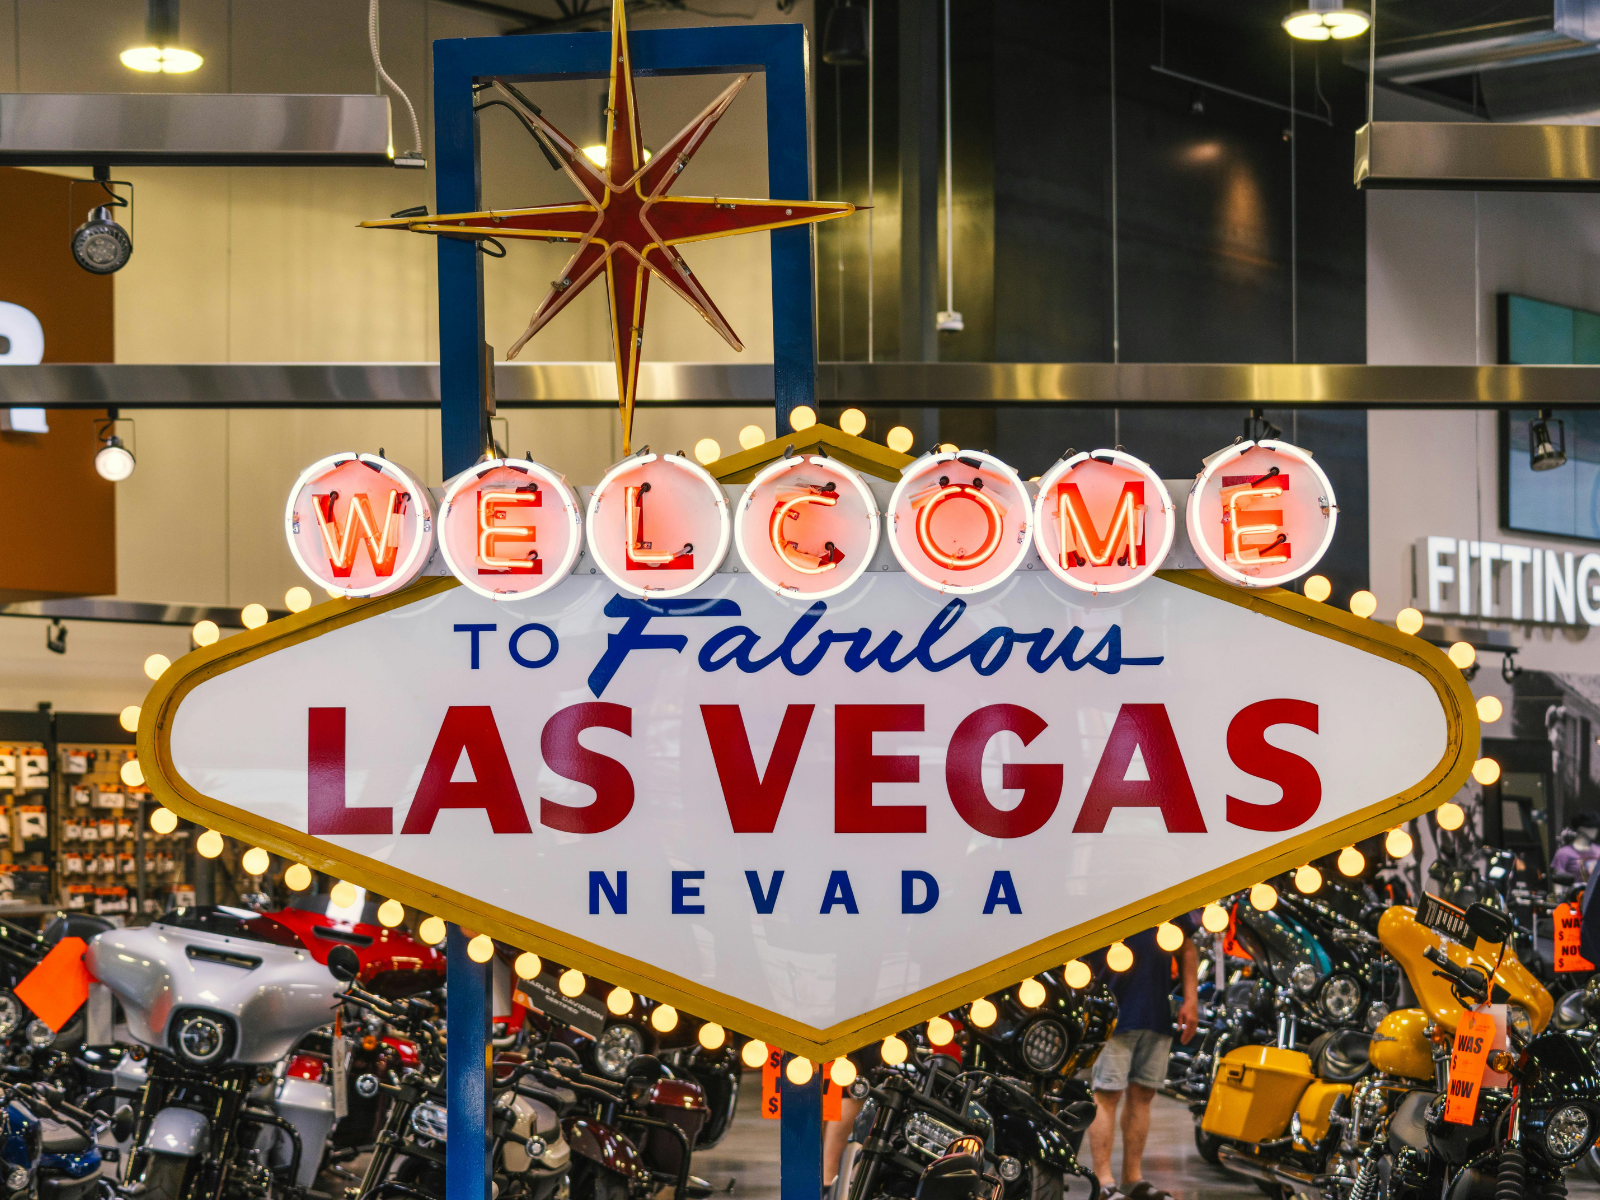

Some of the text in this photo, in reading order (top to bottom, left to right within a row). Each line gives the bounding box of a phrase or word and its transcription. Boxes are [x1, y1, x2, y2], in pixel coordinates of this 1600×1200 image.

[312, 474, 1290, 577] WELCOME
[1427, 535, 1600, 626] FITTING
[454, 593, 1164, 699] TO Fabulous
[308, 699, 1322, 838] LAS VEGAS
[589, 870, 1022, 914] NEVADA
[1561, 918, 1580, 928] WA
[1561, 945, 1581, 956] NO
[1458, 1034, 1483, 1054] WAS
[770, 1051, 780, 1069] $
[1450, 1079, 1474, 1098] NOW
[768, 1096, 778, 1114] $
